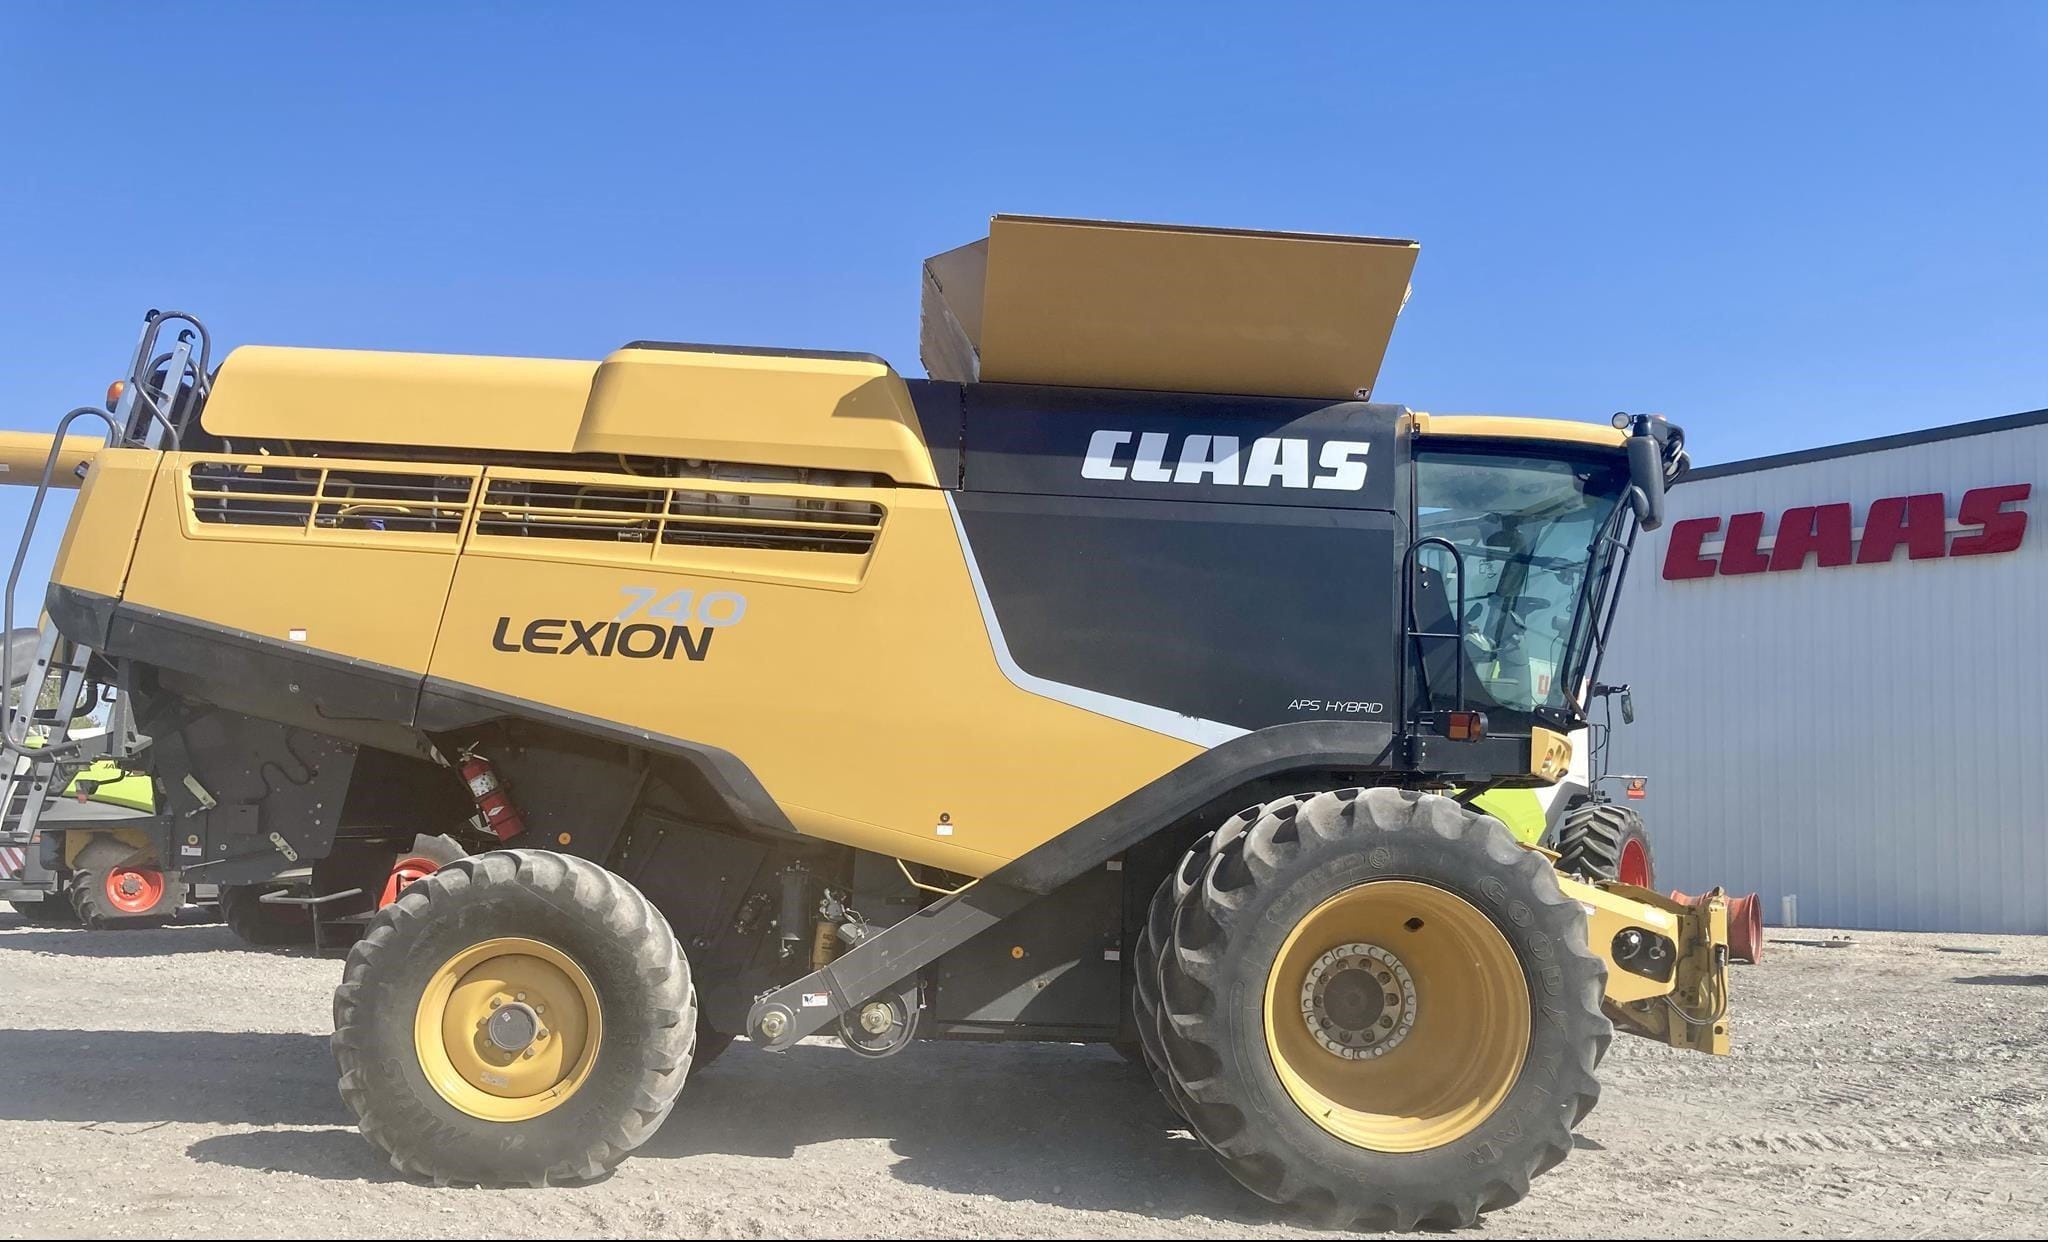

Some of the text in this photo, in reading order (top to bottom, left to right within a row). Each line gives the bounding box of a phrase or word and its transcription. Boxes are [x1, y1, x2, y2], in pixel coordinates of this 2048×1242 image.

[1080, 430, 1370, 491] CLAAS
[1662, 483, 2032, 581] CLAAS
[617, 585, 748, 628] 740
[492, 616, 714, 662] LEXION
[1287, 699, 1383, 714] APS HYBRID
[1464, 875, 1566, 1170] GOODYAR
